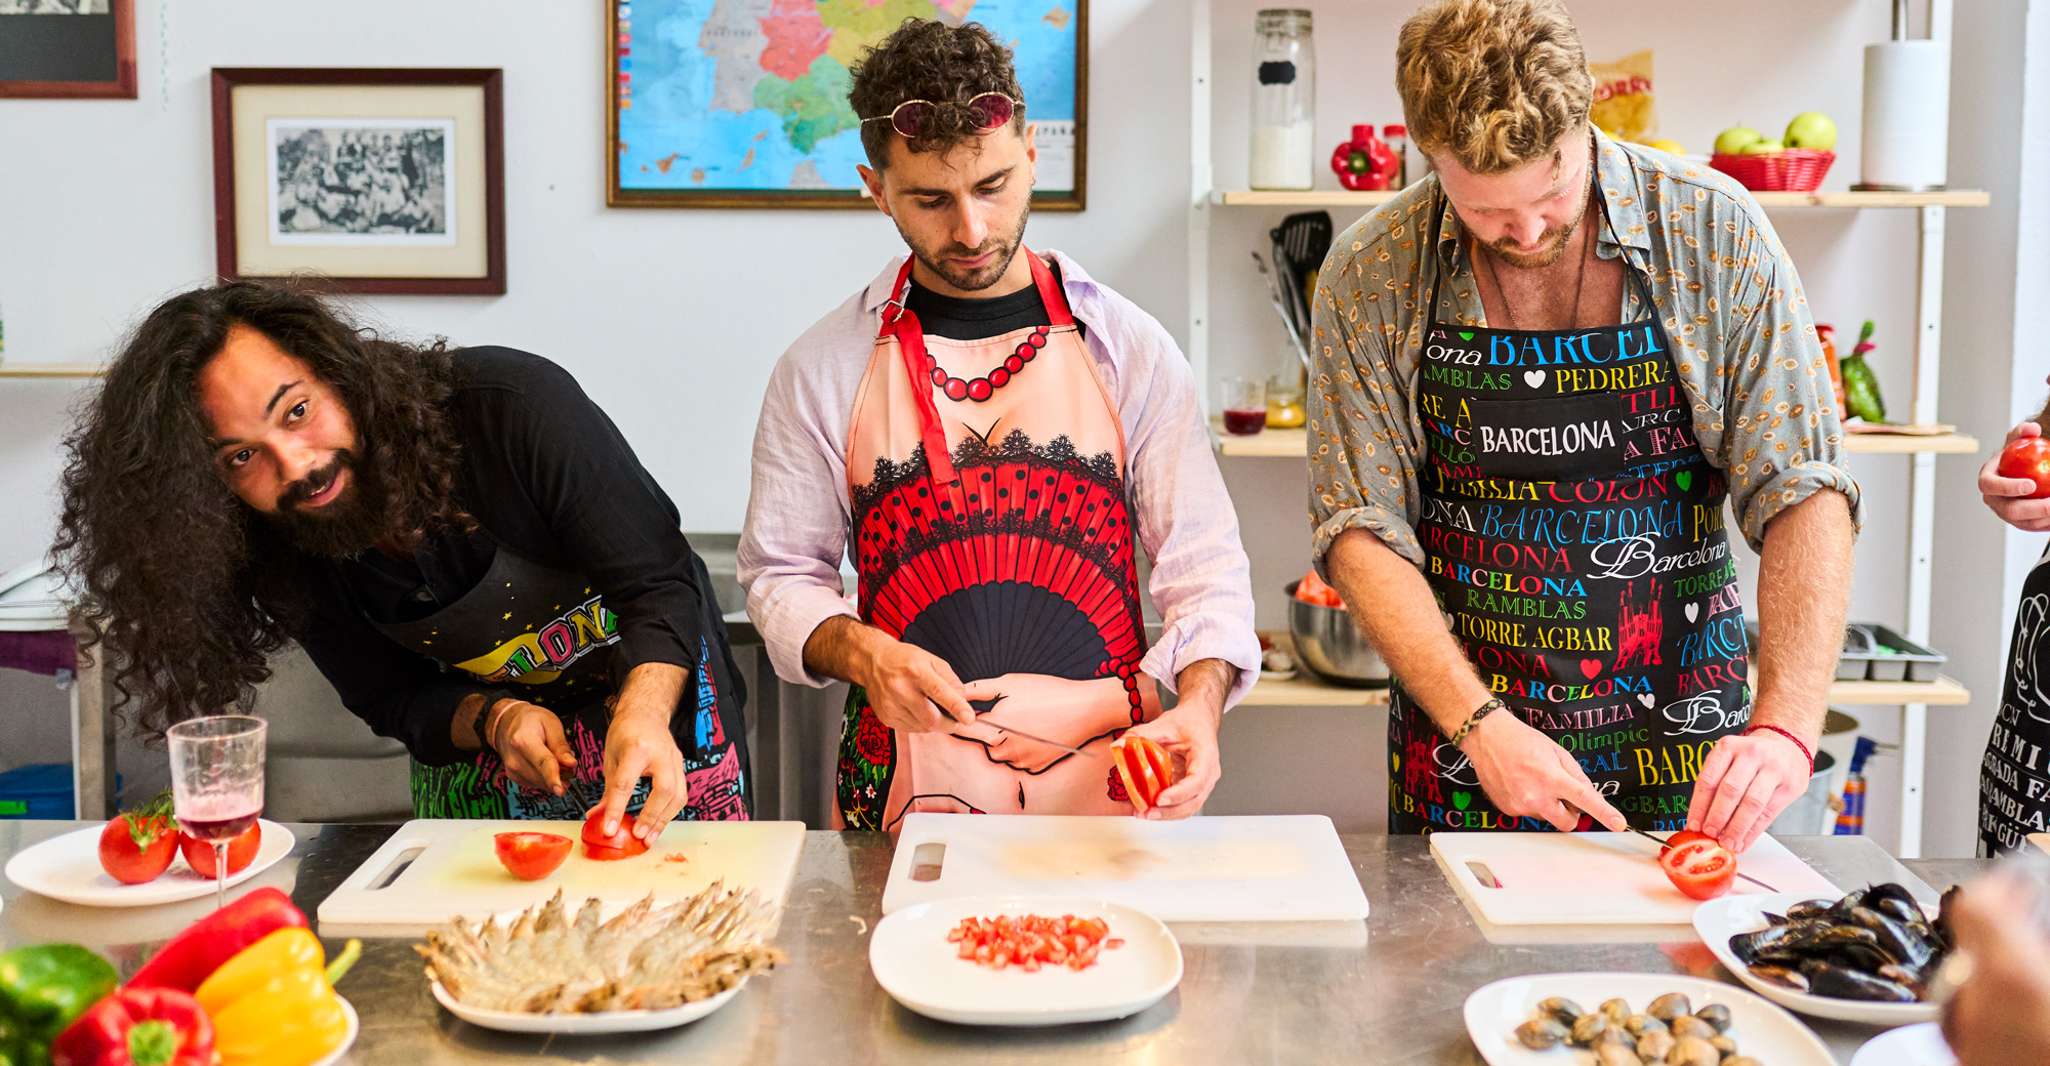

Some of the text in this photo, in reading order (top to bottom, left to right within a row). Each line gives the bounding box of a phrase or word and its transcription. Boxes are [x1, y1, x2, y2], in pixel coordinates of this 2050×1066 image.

[1480, 419, 1616, 456] BARCELONA
[1480, 498, 1683, 553] BARCELONA
[1431, 555, 1588, 598] BARCELONA
[1466, 588, 1587, 620] RAMBLAS
[1457, 611, 1613, 651] TORRE AGBAR
[1490, 673, 1654, 703] BARCELONA
